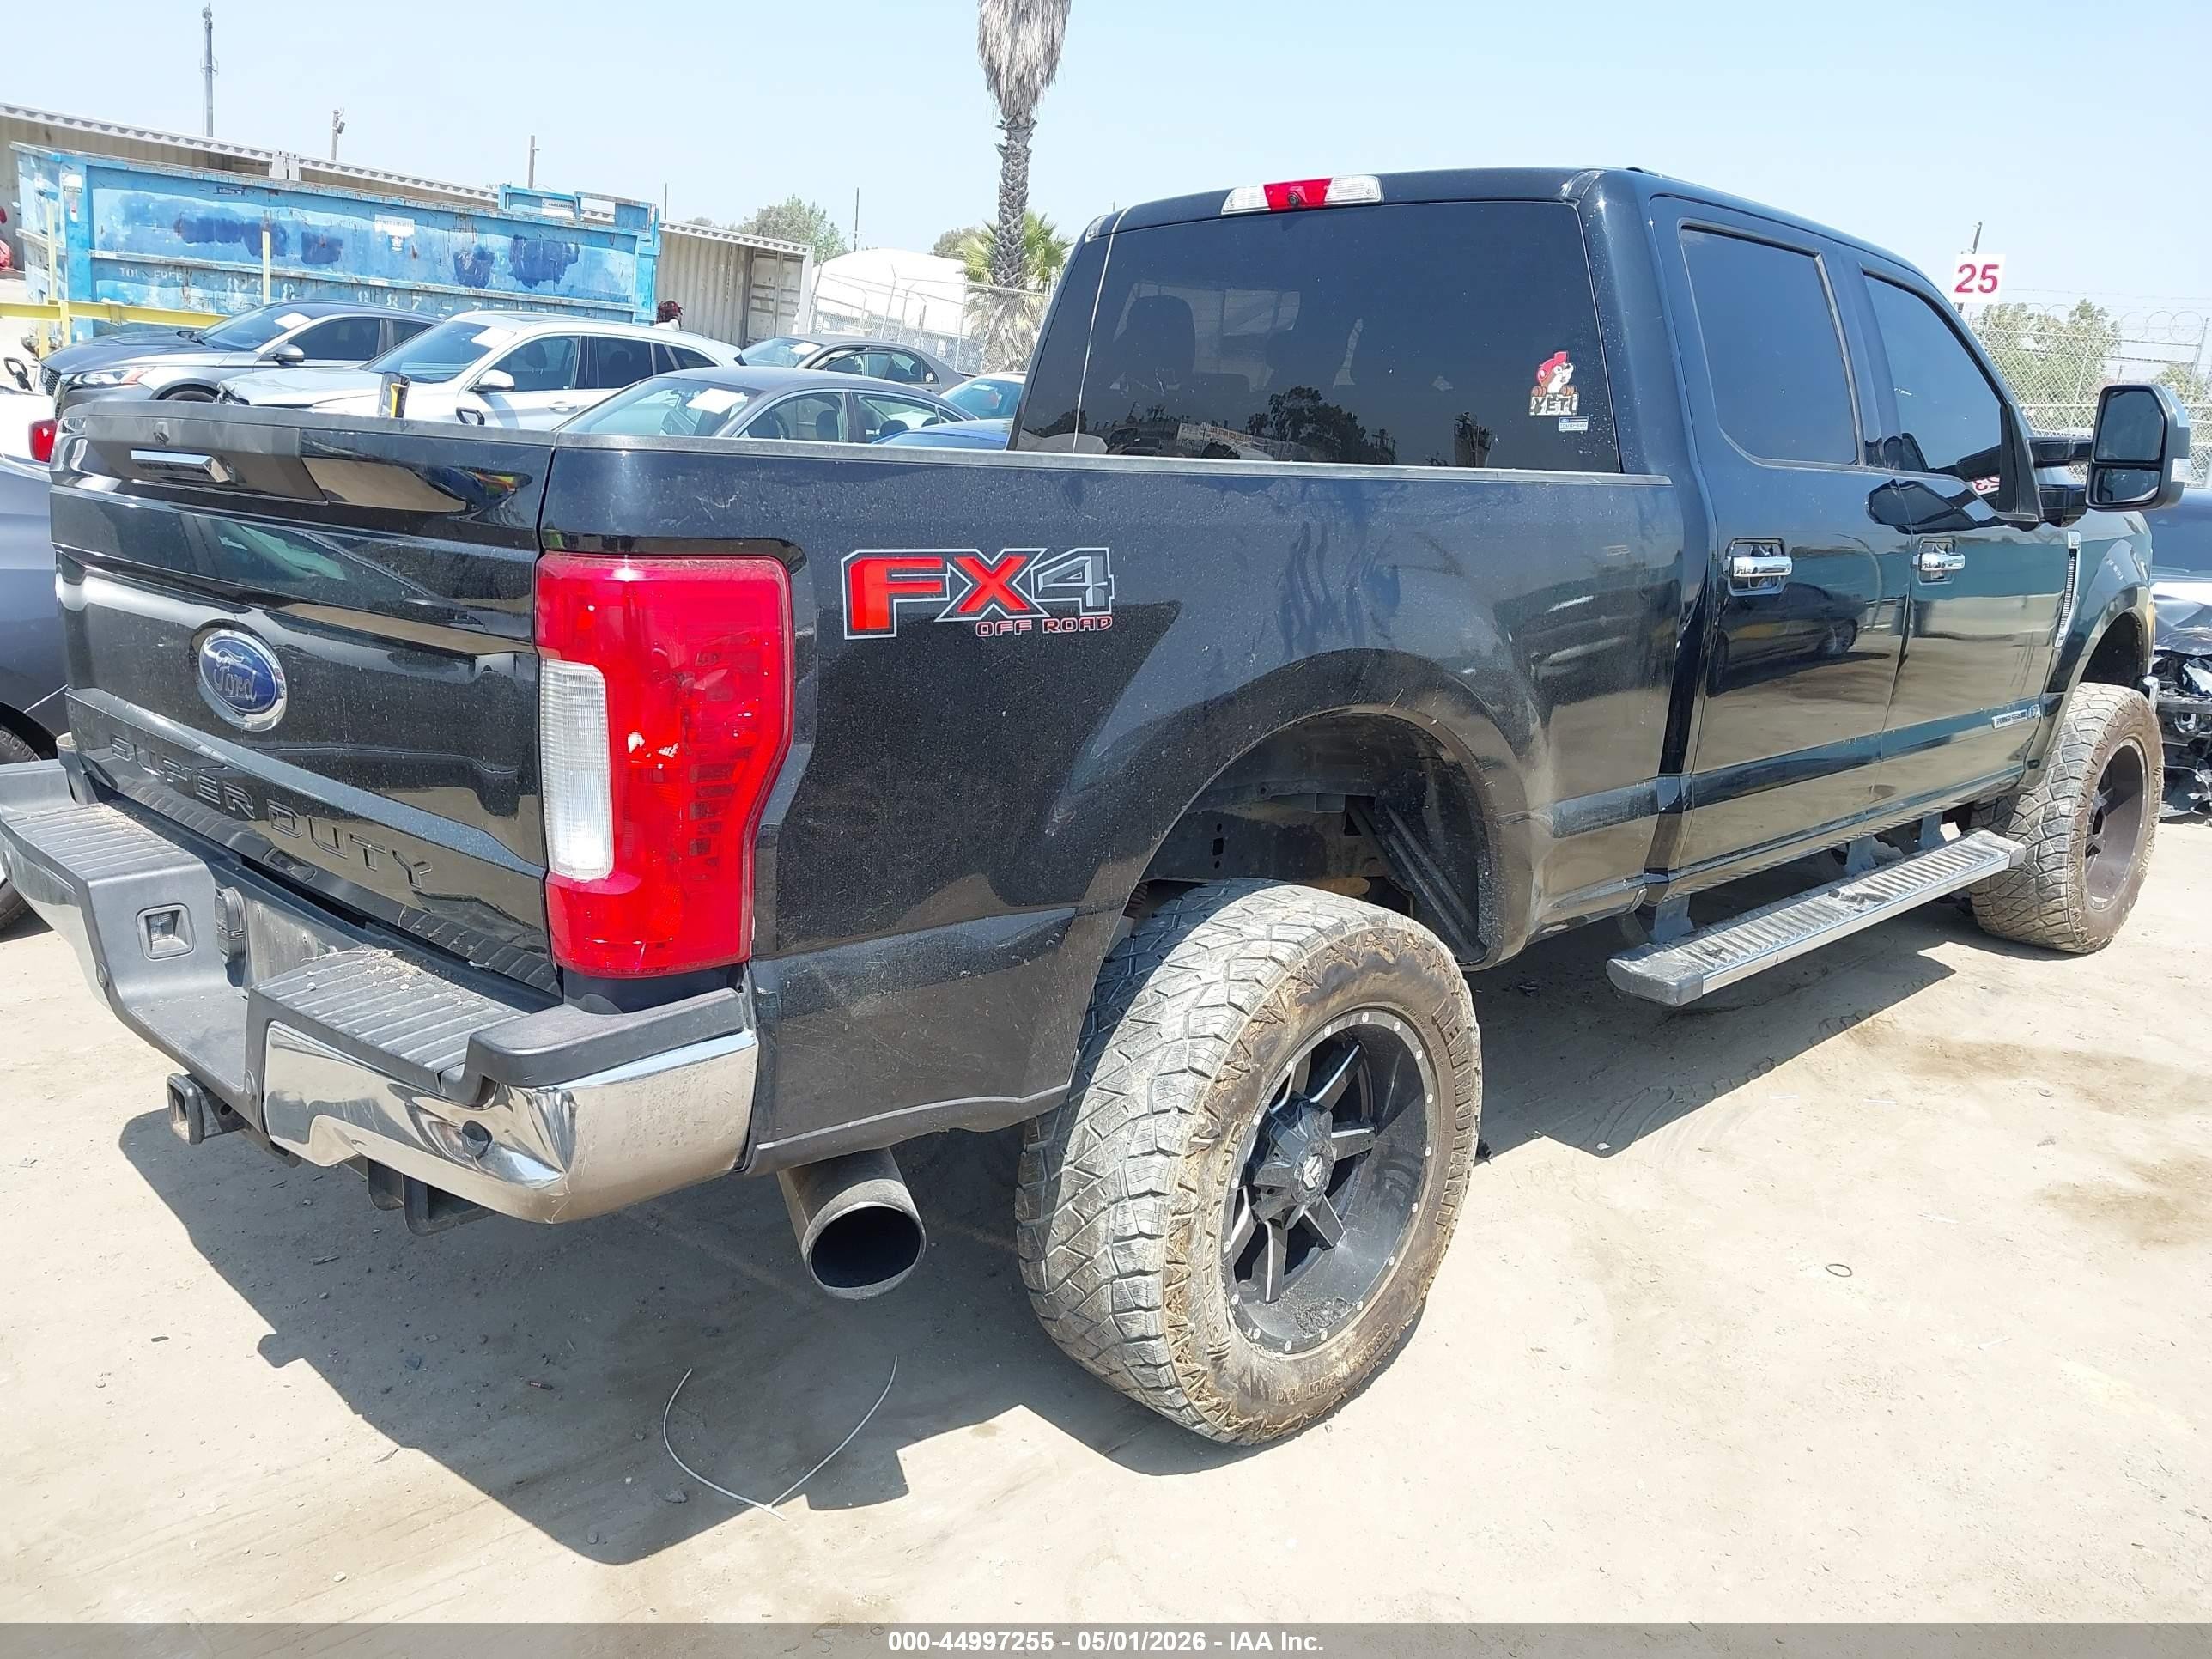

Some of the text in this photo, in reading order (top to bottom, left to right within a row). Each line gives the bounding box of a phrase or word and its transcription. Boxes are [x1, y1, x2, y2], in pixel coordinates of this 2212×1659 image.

[1954, 263, 2000, 294] 25
[1532, 397, 1575, 414] YETI
[841, 547, 1115, 641] FX4
[975, 615, 1114, 638] OFF ROAD
[206, 647, 258, 703] Ford
[109, 734, 434, 890] SUPER DUTY
